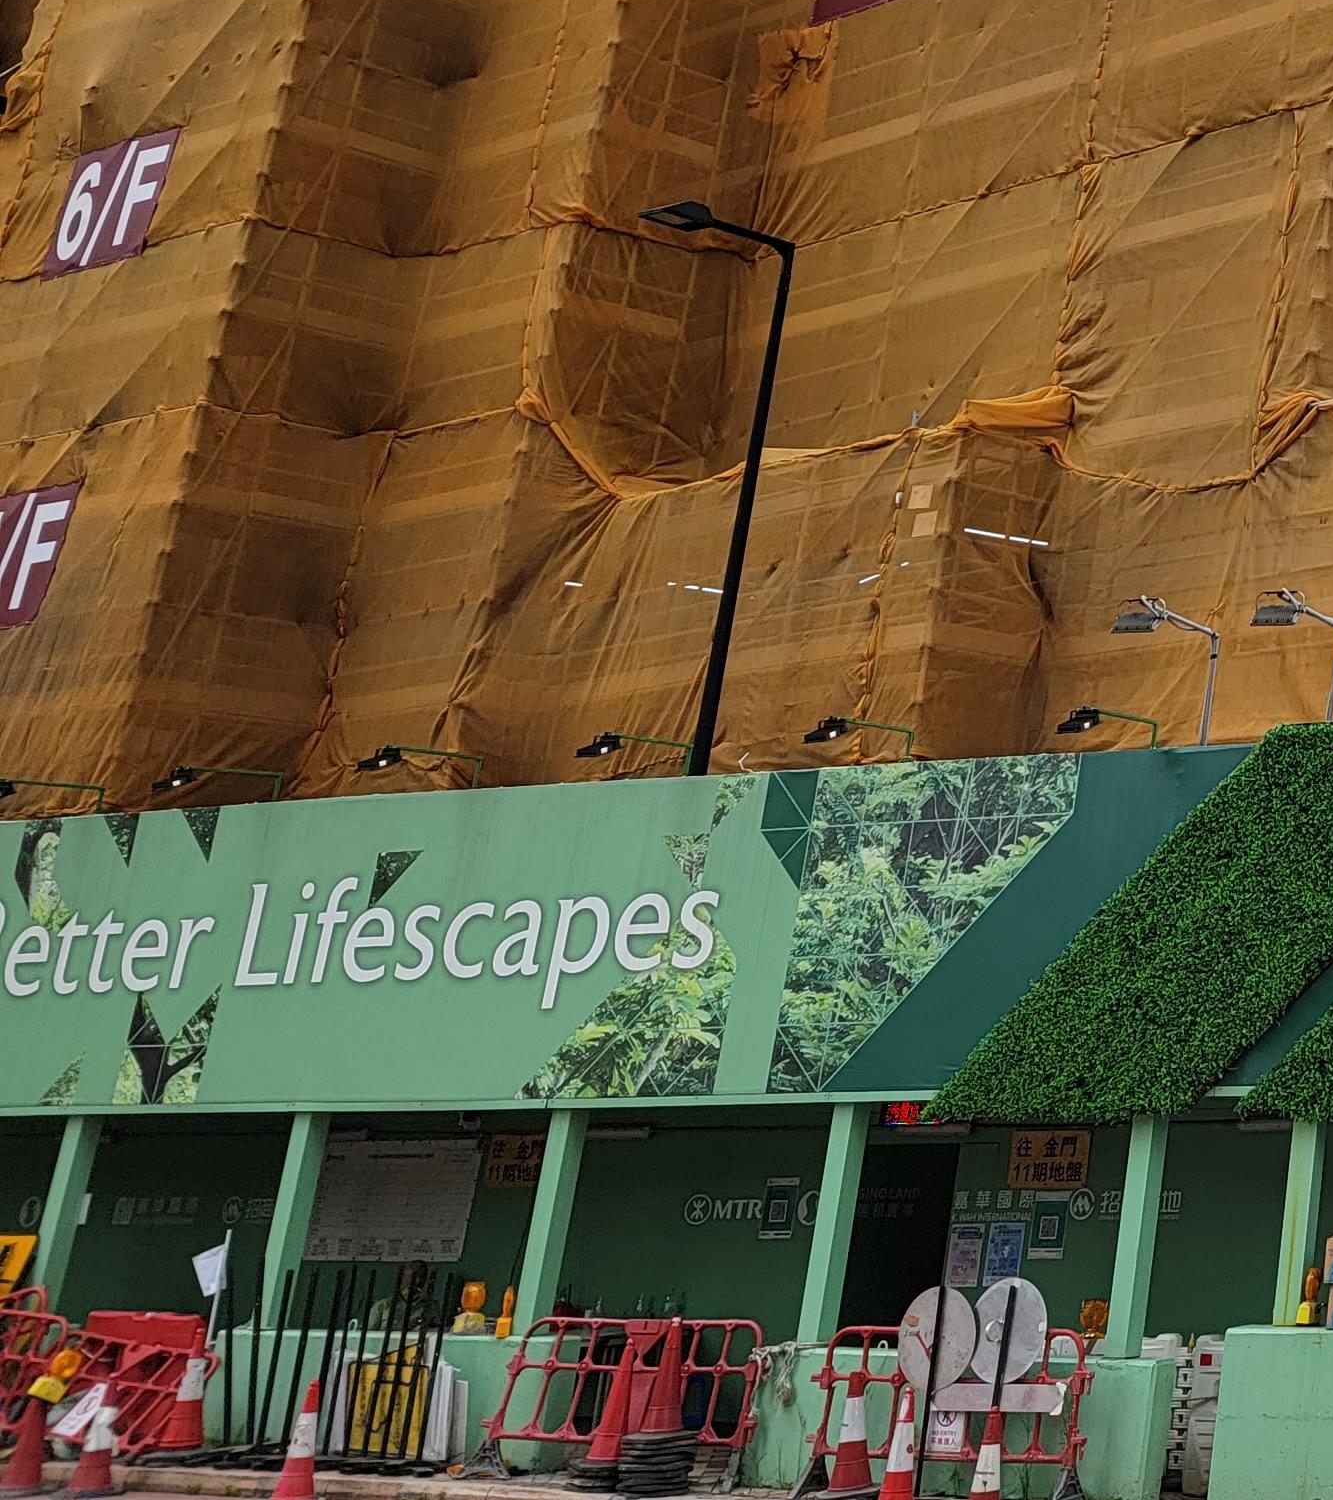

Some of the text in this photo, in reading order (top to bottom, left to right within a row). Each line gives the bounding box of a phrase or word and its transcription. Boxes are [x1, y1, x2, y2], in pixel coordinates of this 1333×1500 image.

[56, 140, 170, 266] 6/F
[0, 492, 70, 610] /F
[0, 876, 720, 1010] etter Lifescapes
[1013, 1162, 1083, 1183] 11期地盤
[1016, 1136, 1077, 1157] 往 金門
[713, 1199, 763, 1221] MTR
